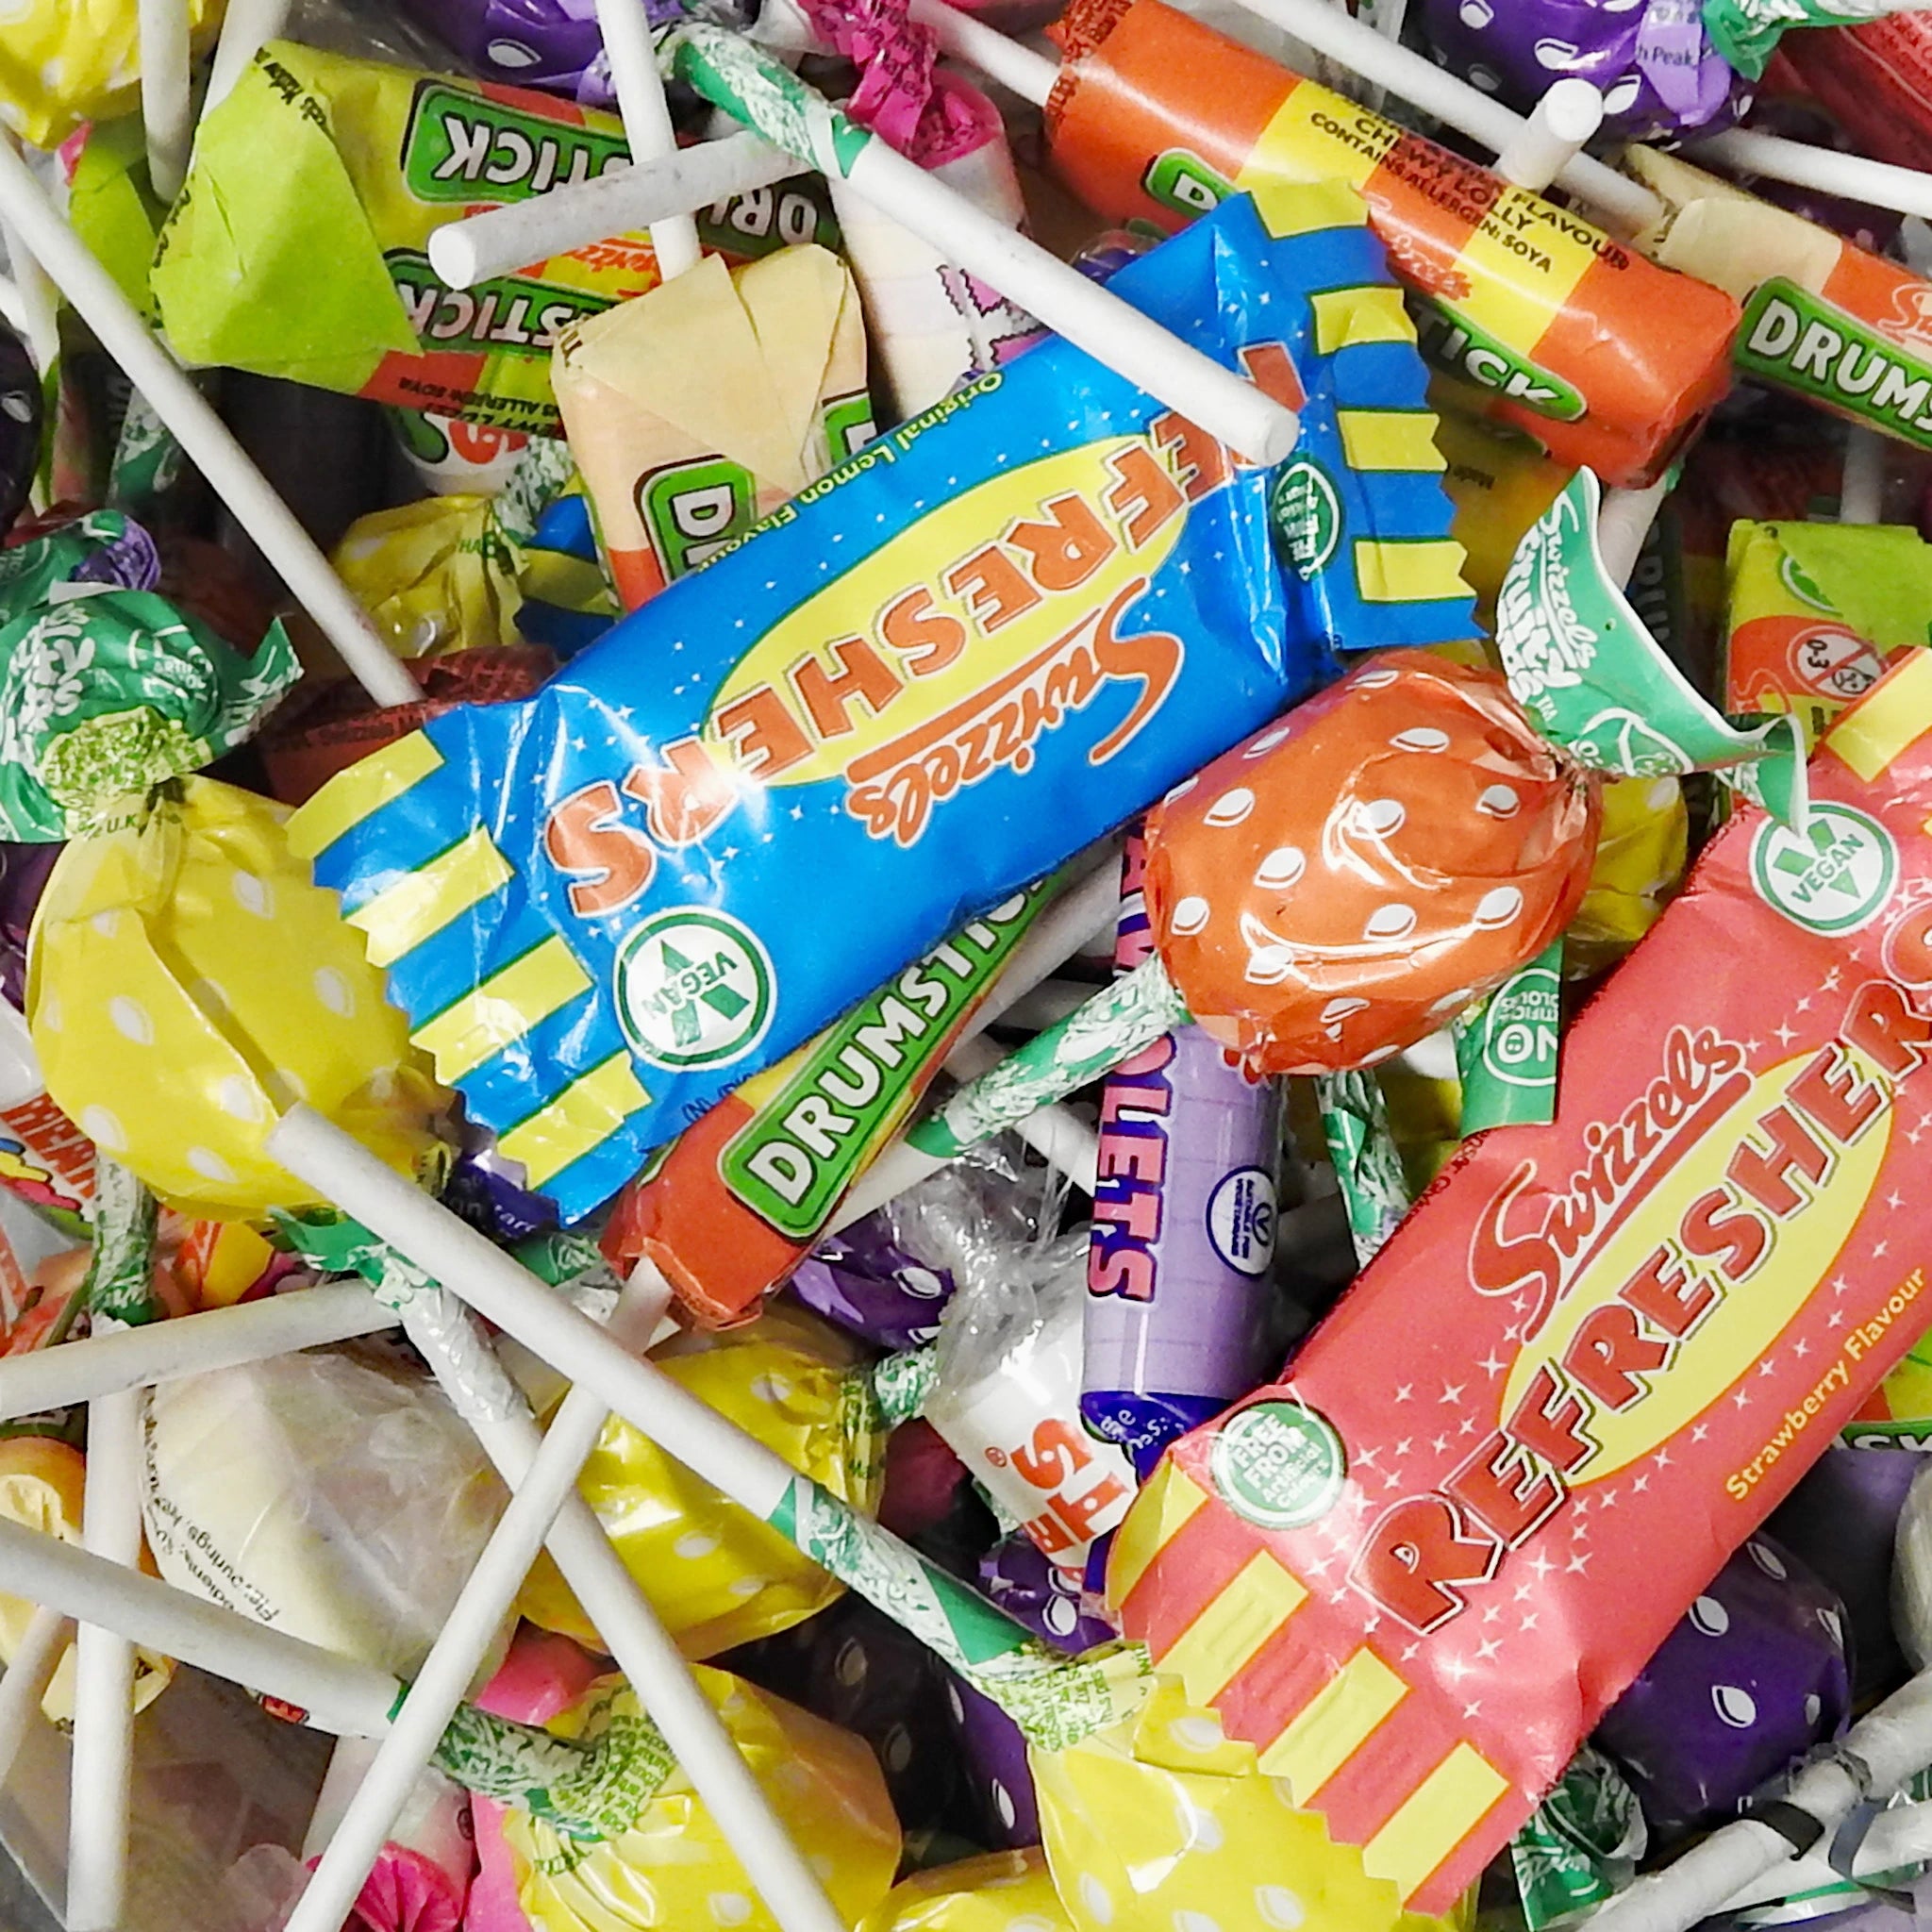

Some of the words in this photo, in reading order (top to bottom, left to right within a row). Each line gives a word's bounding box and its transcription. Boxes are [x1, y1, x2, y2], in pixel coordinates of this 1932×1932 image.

[1311, 112, 1407, 177] CONTAINS
[1502, 234, 1552, 274] SOYA
[1355, 119, 1453, 186] CHEWY
[1454, 182, 1534, 233] LOLLY
[1511, 192, 1630, 271] FLAVOUR
[893, 372, 1005, 449] Original
[800, 443, 895, 507] Lemon
[697, 502, 798, 573] Flavour
[1538, 489, 1598, 671] Swizzels
[544, 341, 1300, 918] EFRESHERS
[1806, 639, 1830, 669] 0-3
[845, 577, 1185, 849] Swizzels
[1790, 833, 1866, 903] VEGAN
[641, 951, 738, 1022] VEGAN
[1470, 1024, 1757, 1342] Swizzels
[1725, 1357, 1851, 1503] Strawberry
[1843, 1268, 1926, 1362] Flavour
[1231, 1415, 1286, 1468] FREE
[1244, 1427, 1307, 1488] FROM
